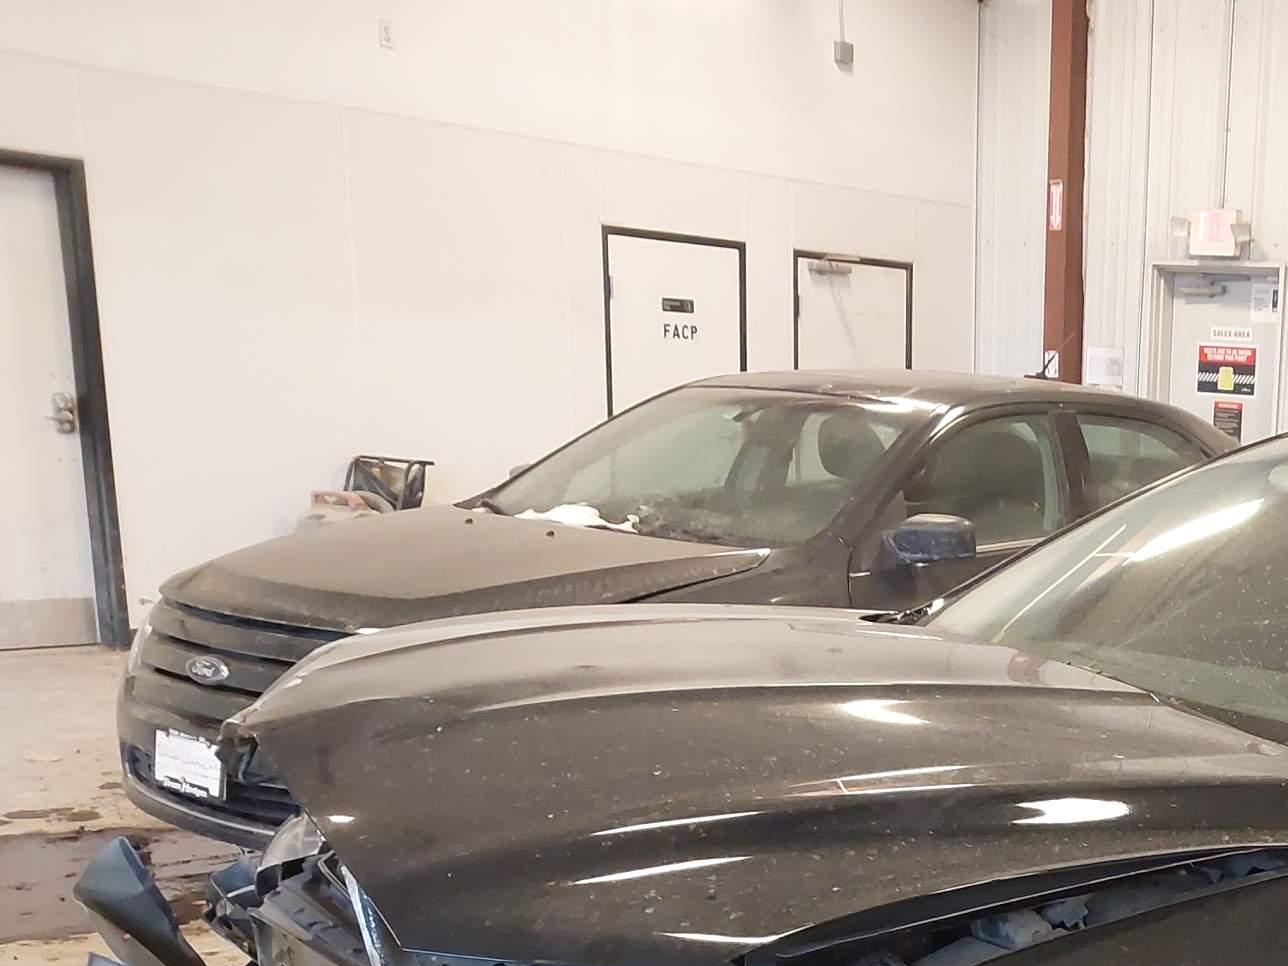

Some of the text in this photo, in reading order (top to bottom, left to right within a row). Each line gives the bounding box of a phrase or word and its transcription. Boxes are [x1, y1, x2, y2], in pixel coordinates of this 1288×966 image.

[663, 323, 698, 340] FACP
[1212, 329, 1250, 338] SALES AREA
[191, 659, 216, 678] Ford
